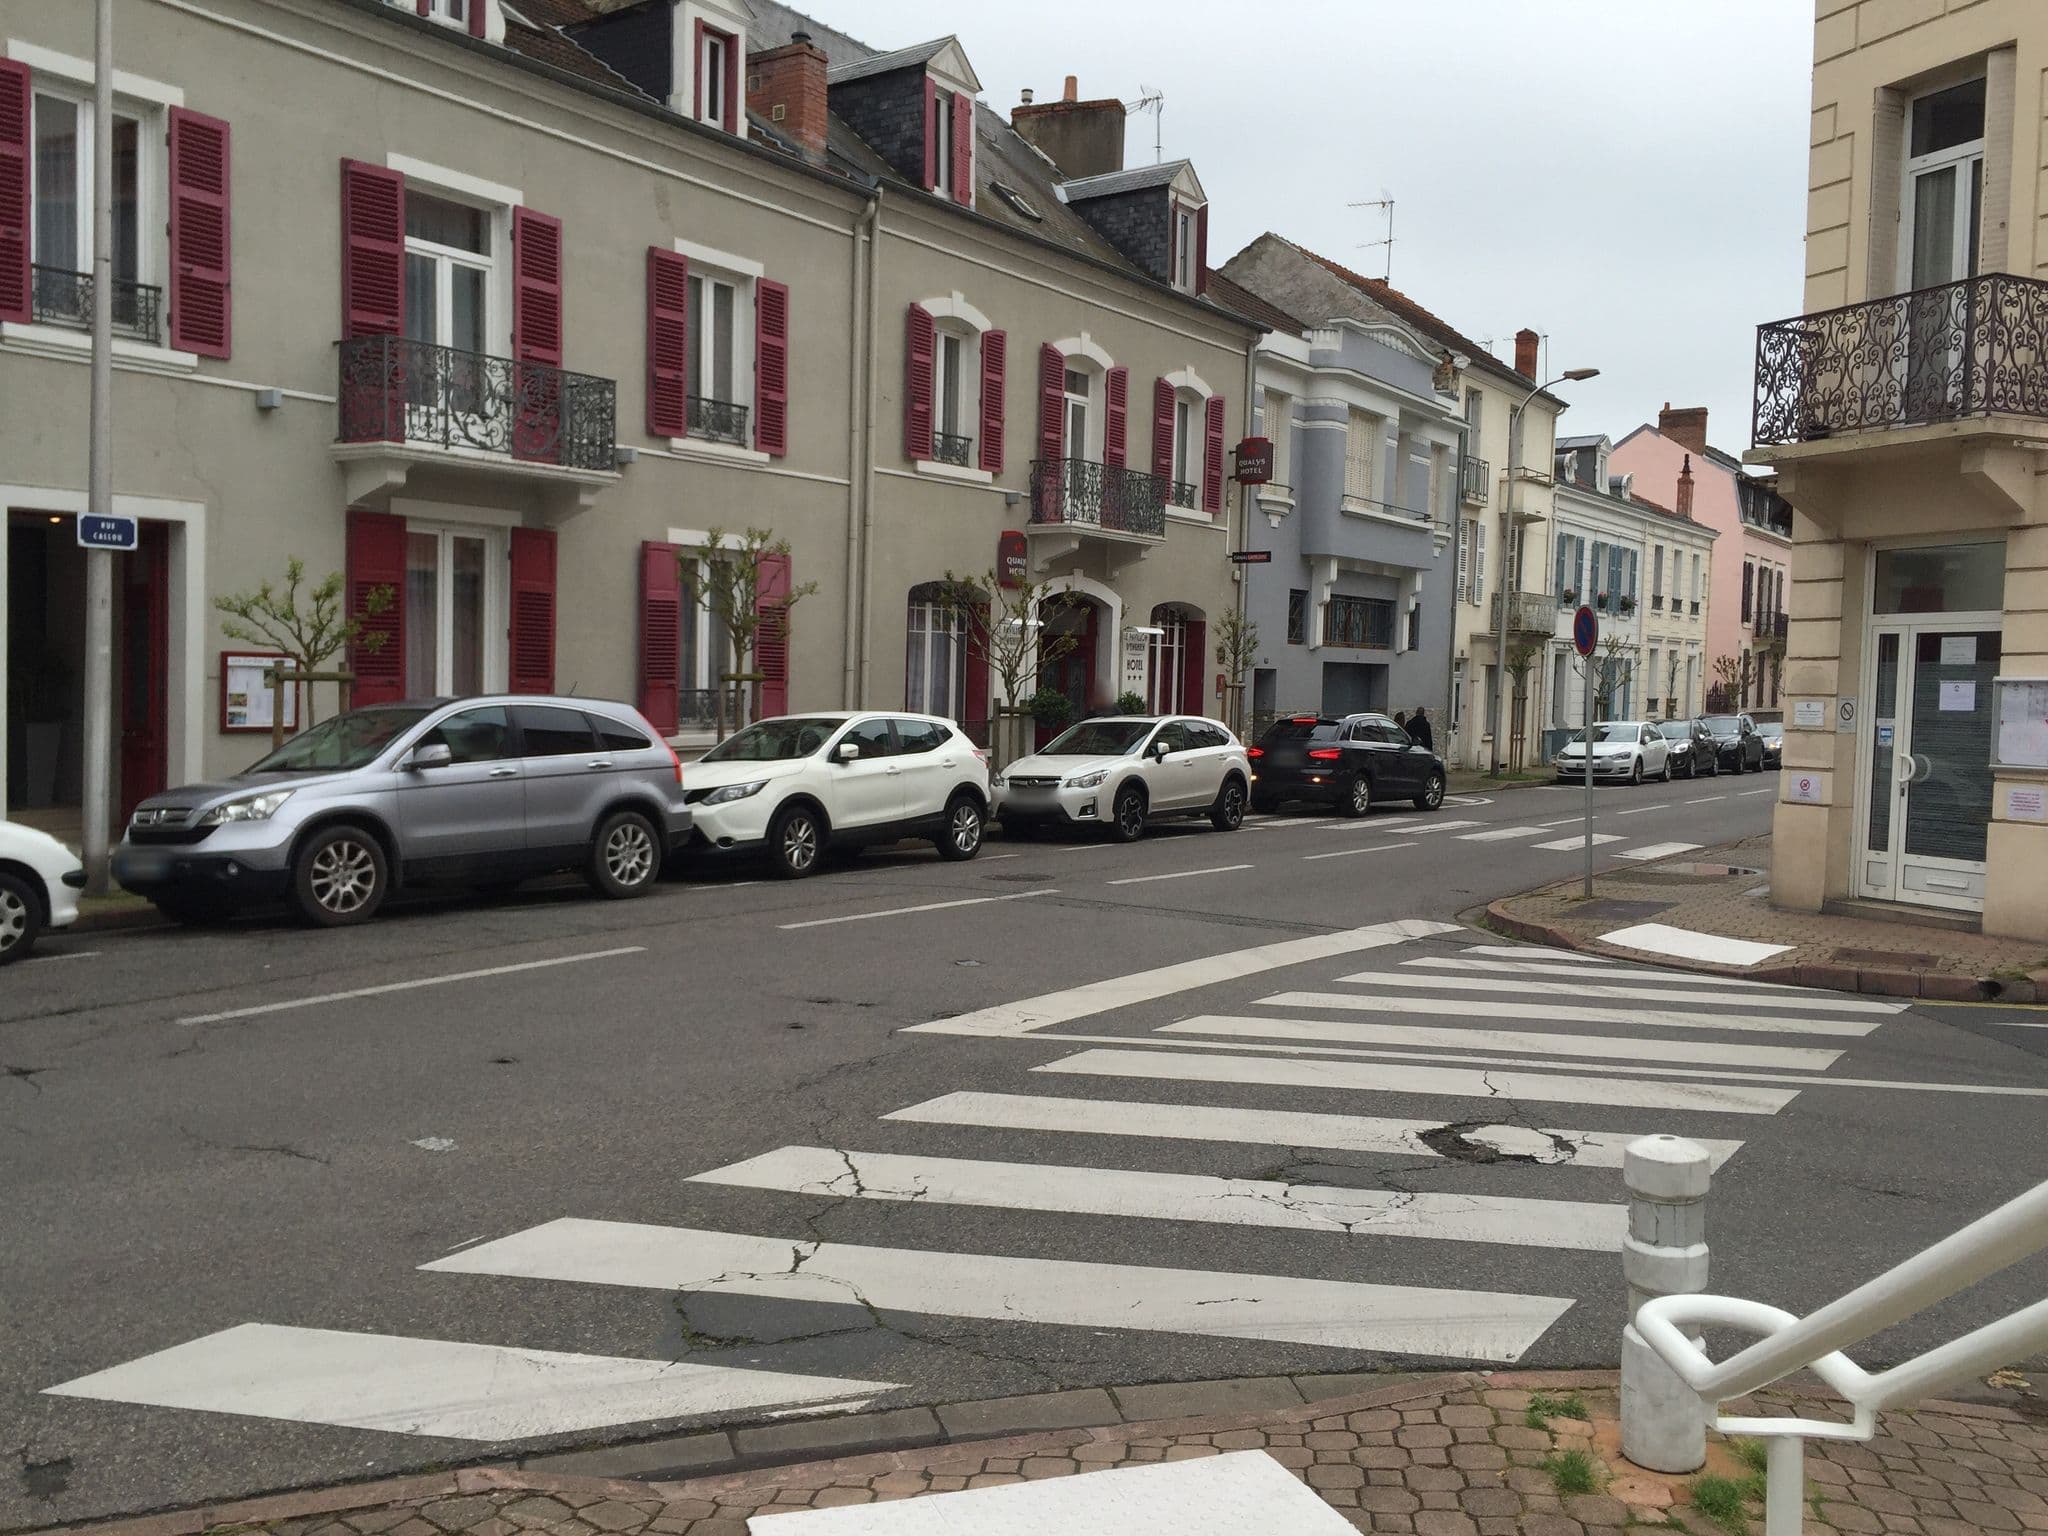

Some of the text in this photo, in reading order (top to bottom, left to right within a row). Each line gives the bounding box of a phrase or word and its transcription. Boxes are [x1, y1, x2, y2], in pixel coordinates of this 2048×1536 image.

[1239, 457, 1266, 467] QUALYS
[1240, 467, 1263, 475] HOTEL
[101, 521, 115, 530] RUE
